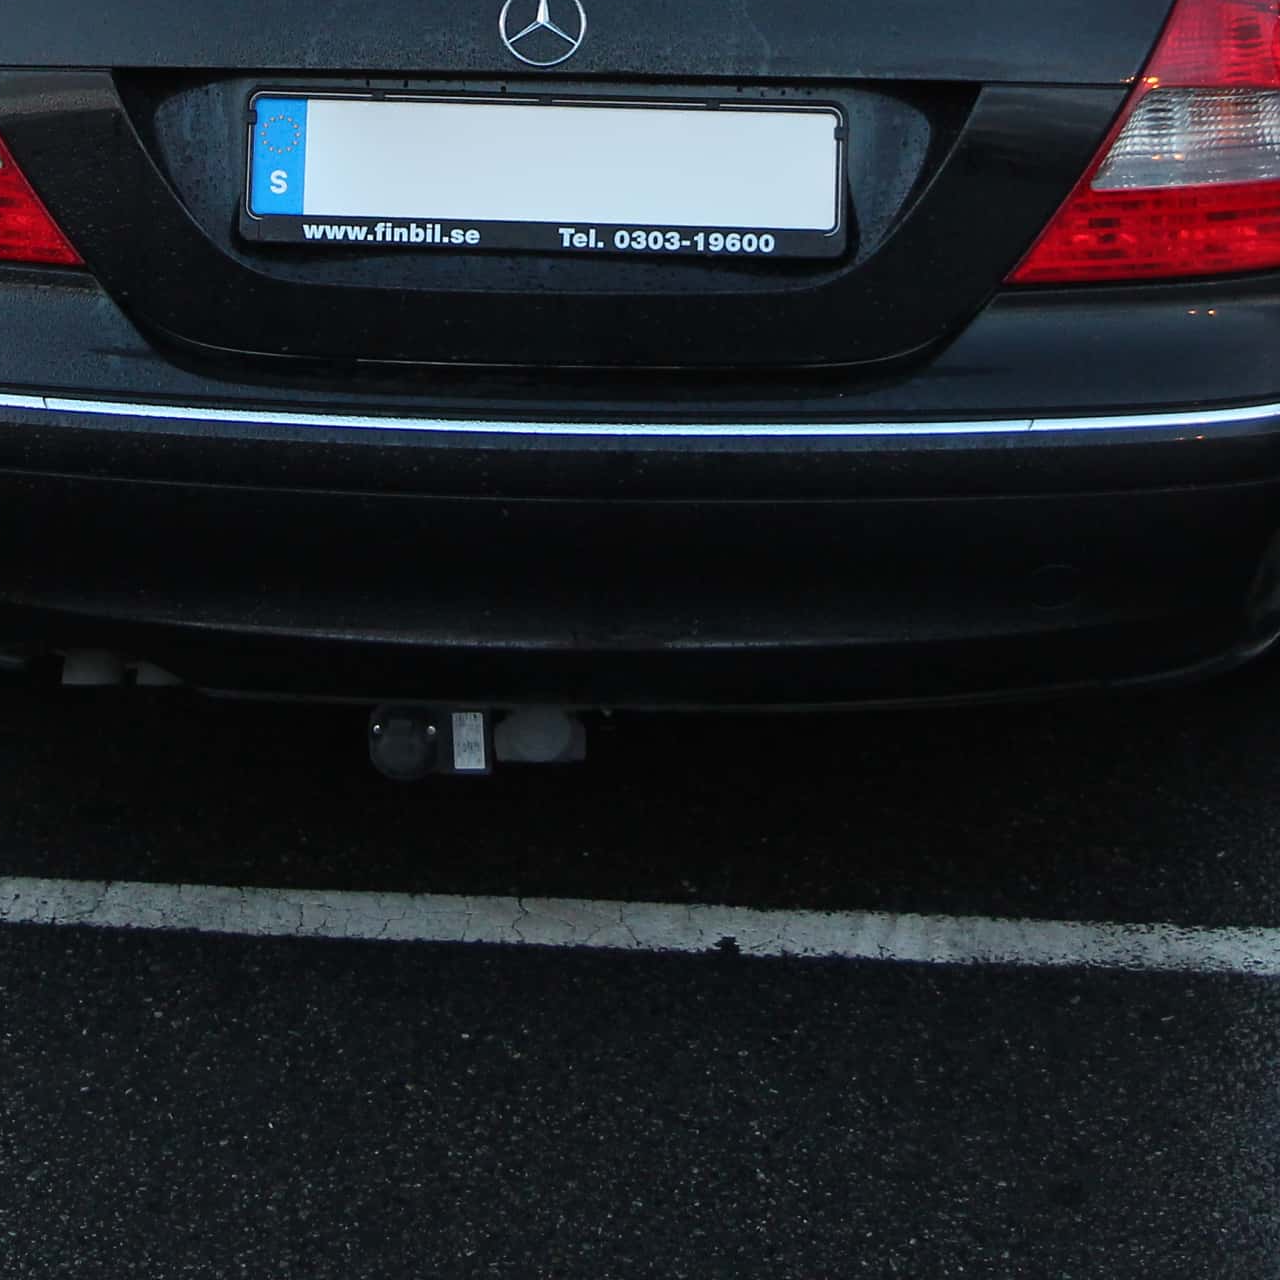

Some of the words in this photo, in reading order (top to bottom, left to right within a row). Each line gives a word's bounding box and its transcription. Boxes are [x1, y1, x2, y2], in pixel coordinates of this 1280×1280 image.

[270, 169, 288, 194] S
[302, 222, 481, 245] www.finbil.se
[558, 226, 604, 249] Tel.
[613, 229, 776, 253] 0303-19600
